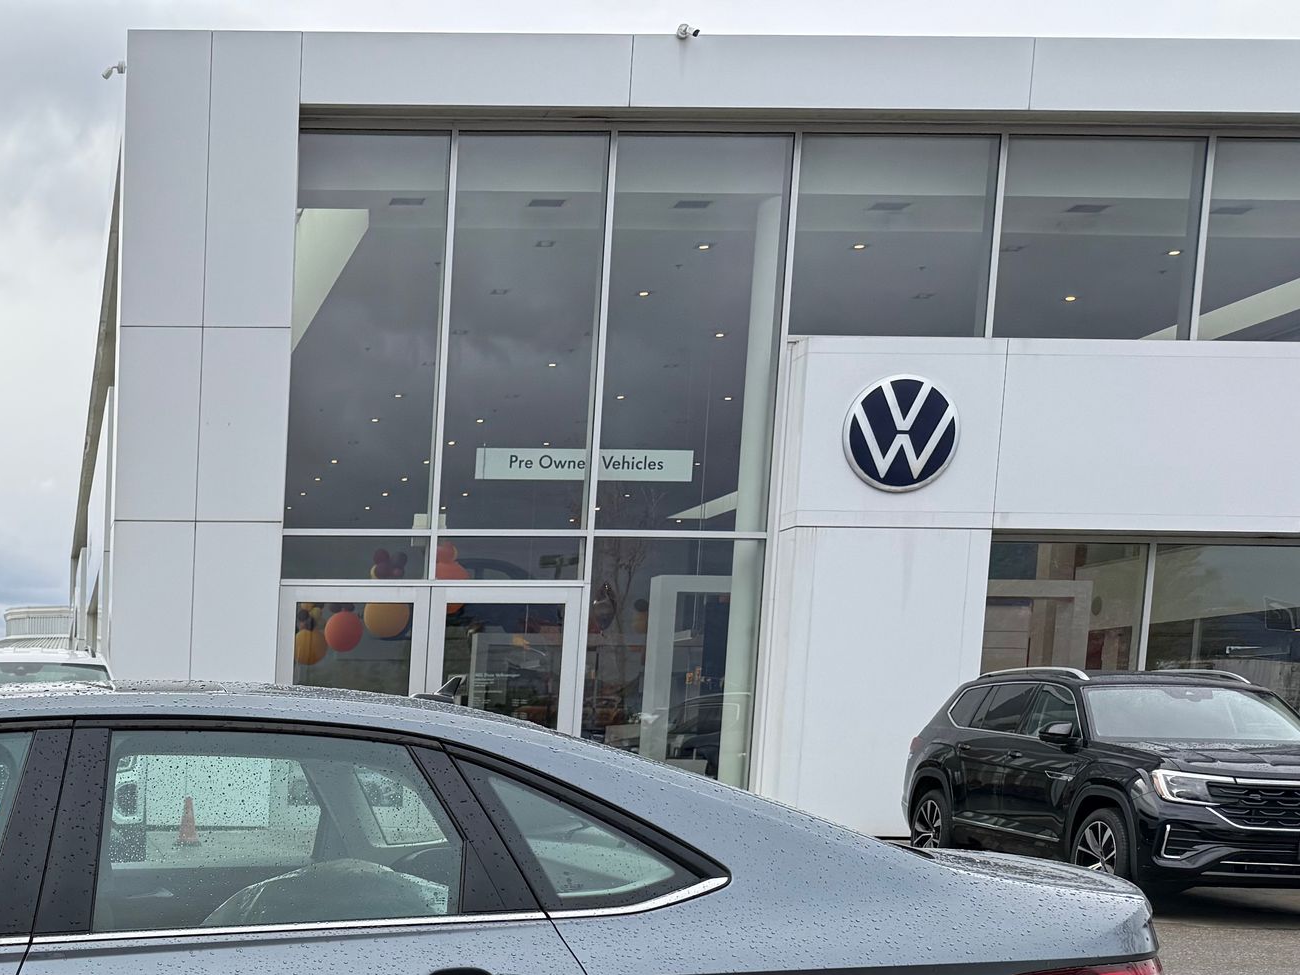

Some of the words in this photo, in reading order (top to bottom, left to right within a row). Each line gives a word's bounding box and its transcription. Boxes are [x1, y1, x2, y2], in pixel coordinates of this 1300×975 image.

[508, 454, 534, 469] Pre
[538, 454, 586, 470] Owne
[601, 455, 664, 471] Vehicles
